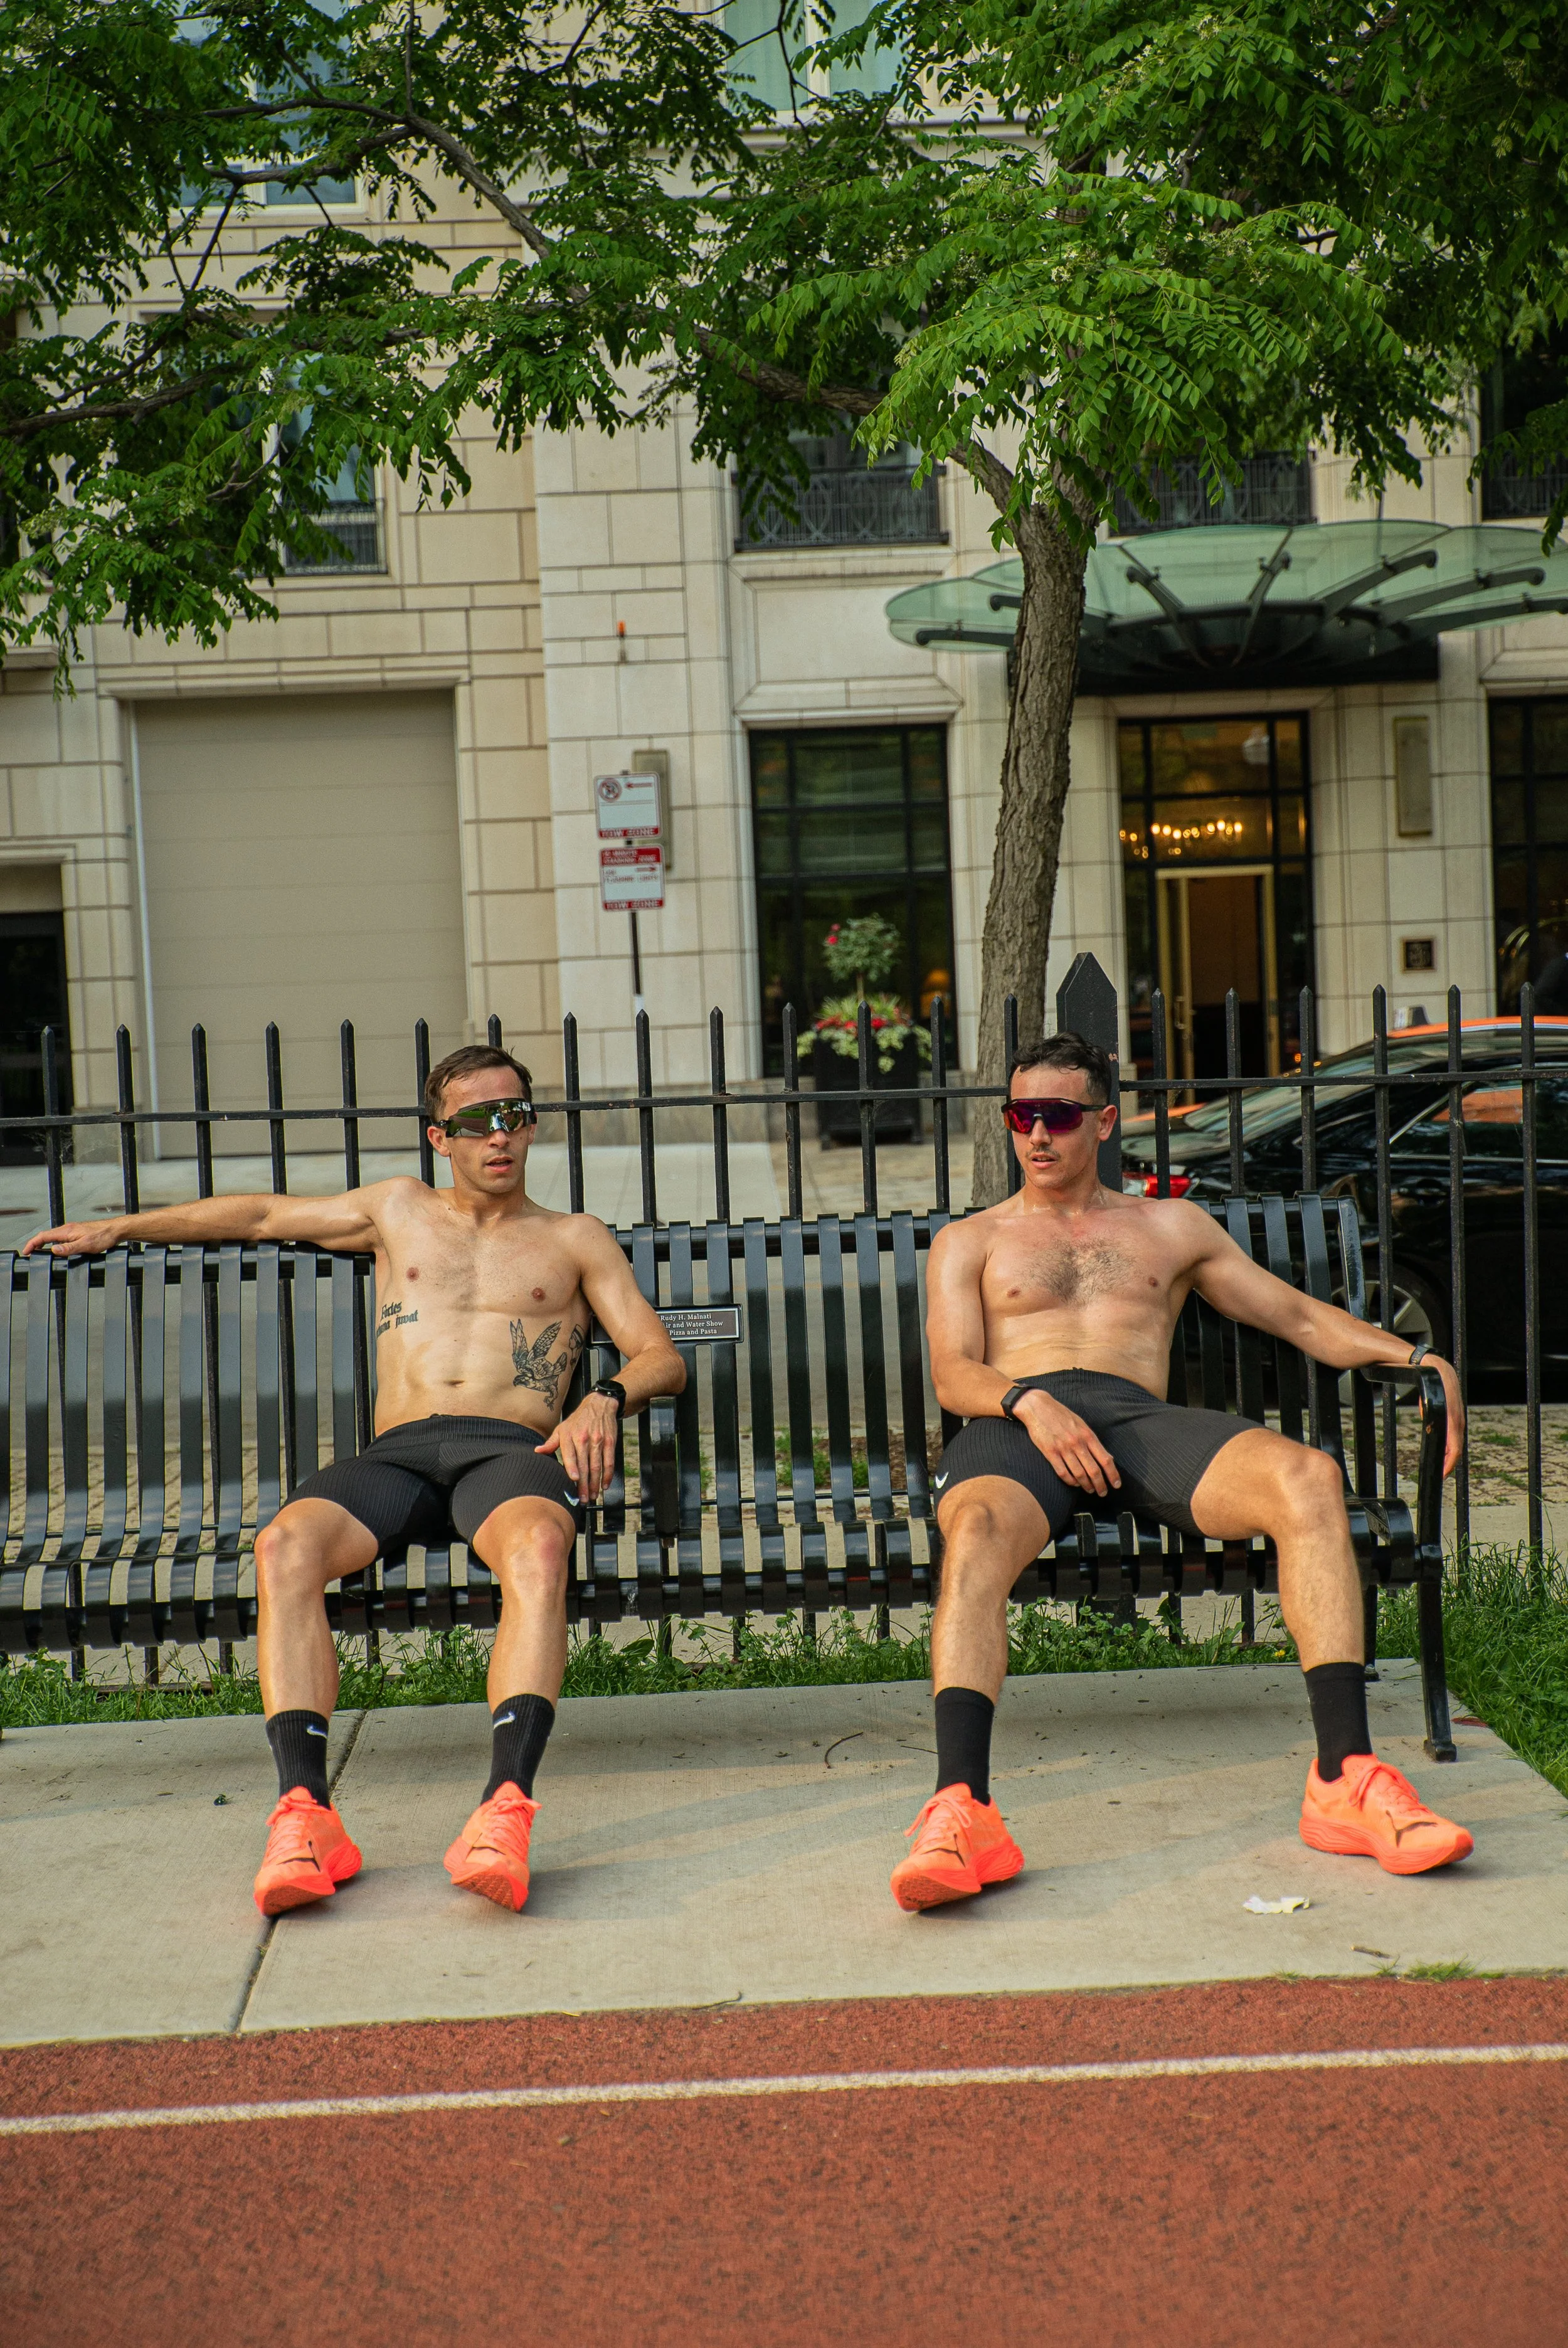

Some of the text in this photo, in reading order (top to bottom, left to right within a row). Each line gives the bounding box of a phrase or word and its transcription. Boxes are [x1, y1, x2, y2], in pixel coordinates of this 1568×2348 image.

[602, 827, 654, 838] TOW ZONE
[606, 898, 659, 909] TOW ZONE
